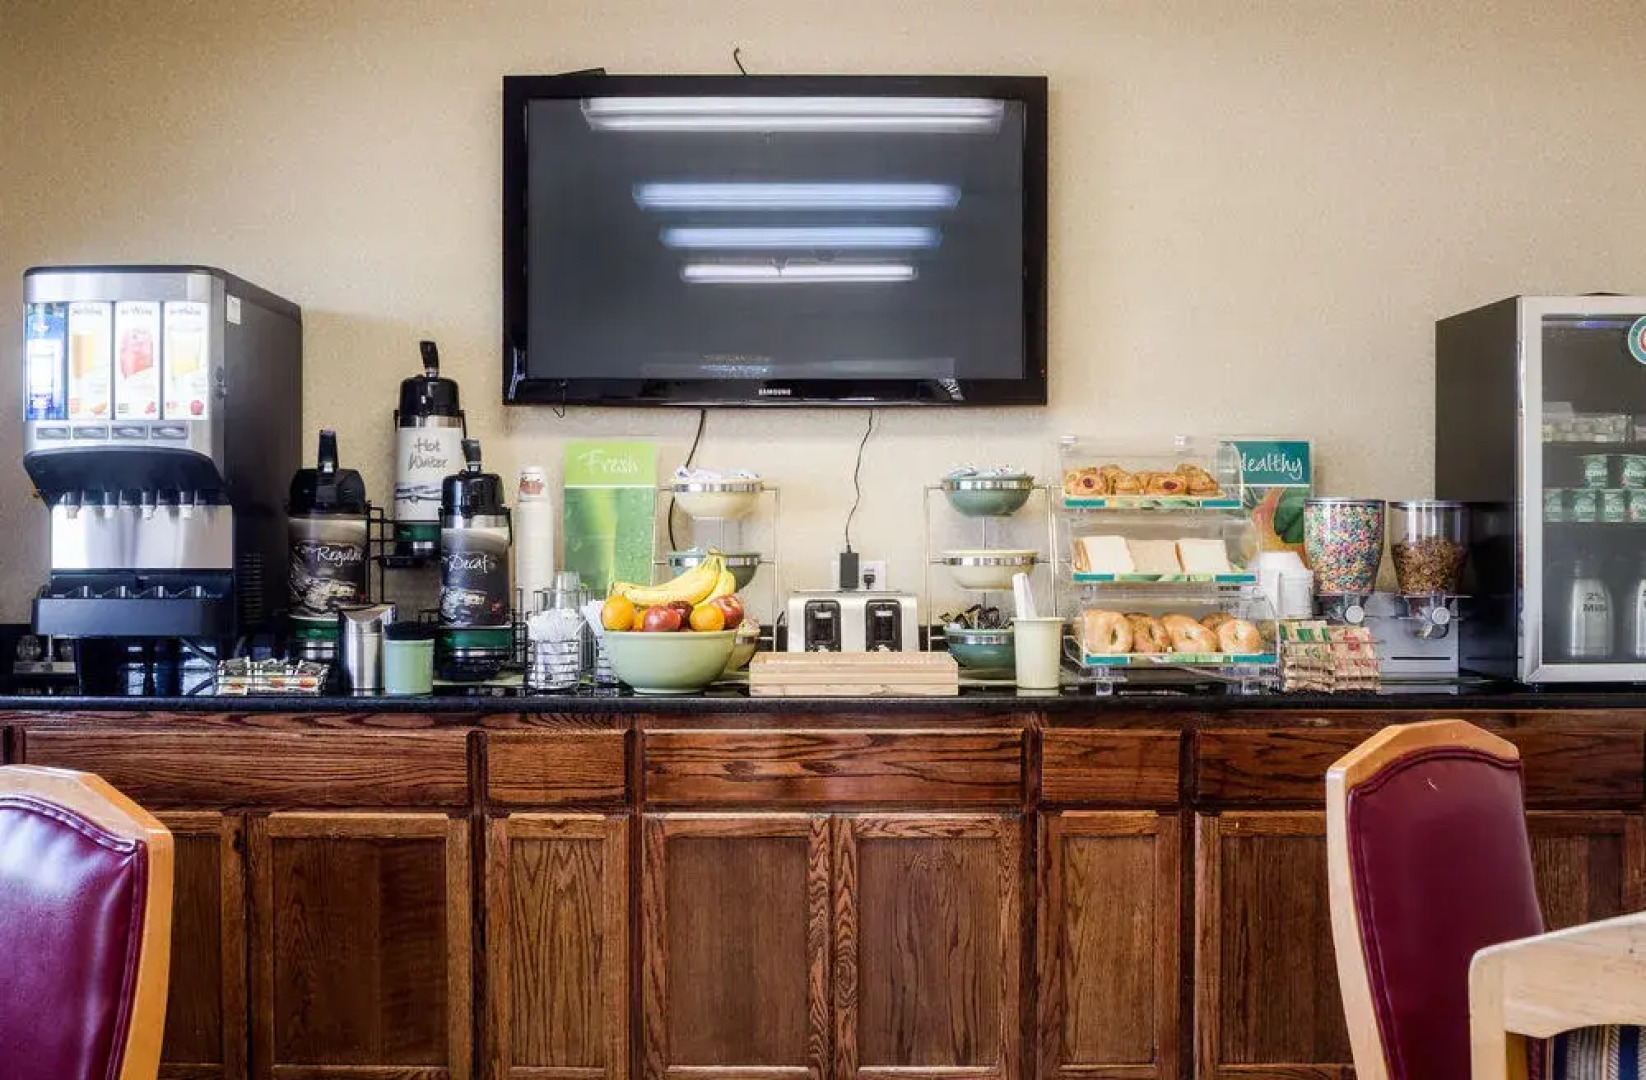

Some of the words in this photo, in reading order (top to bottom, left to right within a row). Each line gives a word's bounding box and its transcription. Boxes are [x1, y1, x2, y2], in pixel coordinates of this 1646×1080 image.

[758, 388, 791, 396] SAMSUNG
[413, 437, 441, 453] Hot
[407, 453, 448, 471] Water
[577, 449, 638, 475] Fresh
[448, 554, 488, 574] Decaf
